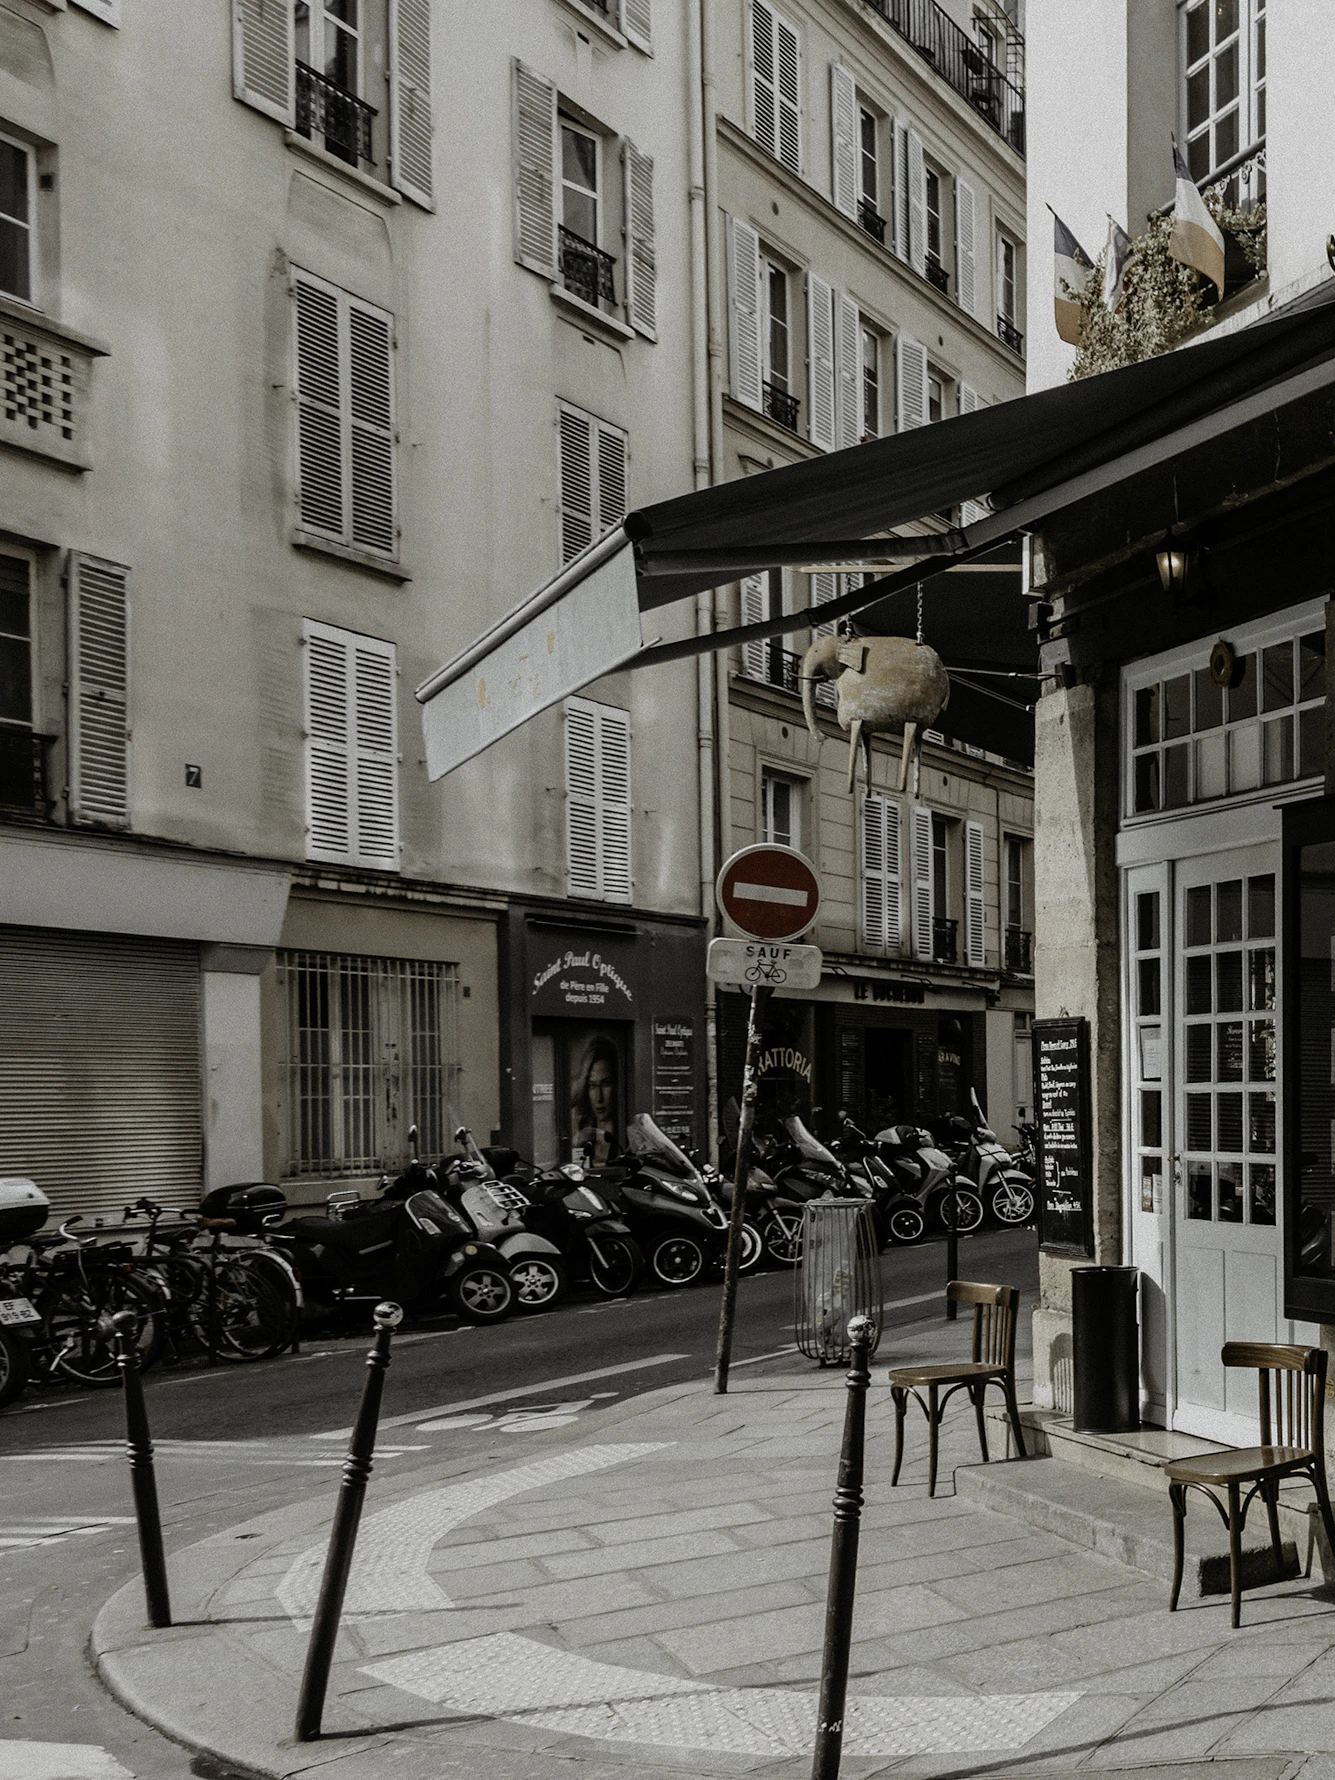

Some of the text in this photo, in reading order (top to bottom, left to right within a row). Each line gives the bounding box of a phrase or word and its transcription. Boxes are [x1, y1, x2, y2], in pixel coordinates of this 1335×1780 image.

[188, 766, 199, 785] 7
[745, 945, 792, 960] SAUF
[532, 950, 634, 1002] Saint Paul Optique
[560, 979, 609, 993] de Père en Fille
[565, 992, 605, 1005] depuis 1954
[757, 1047, 812, 1084] RATTORIA
